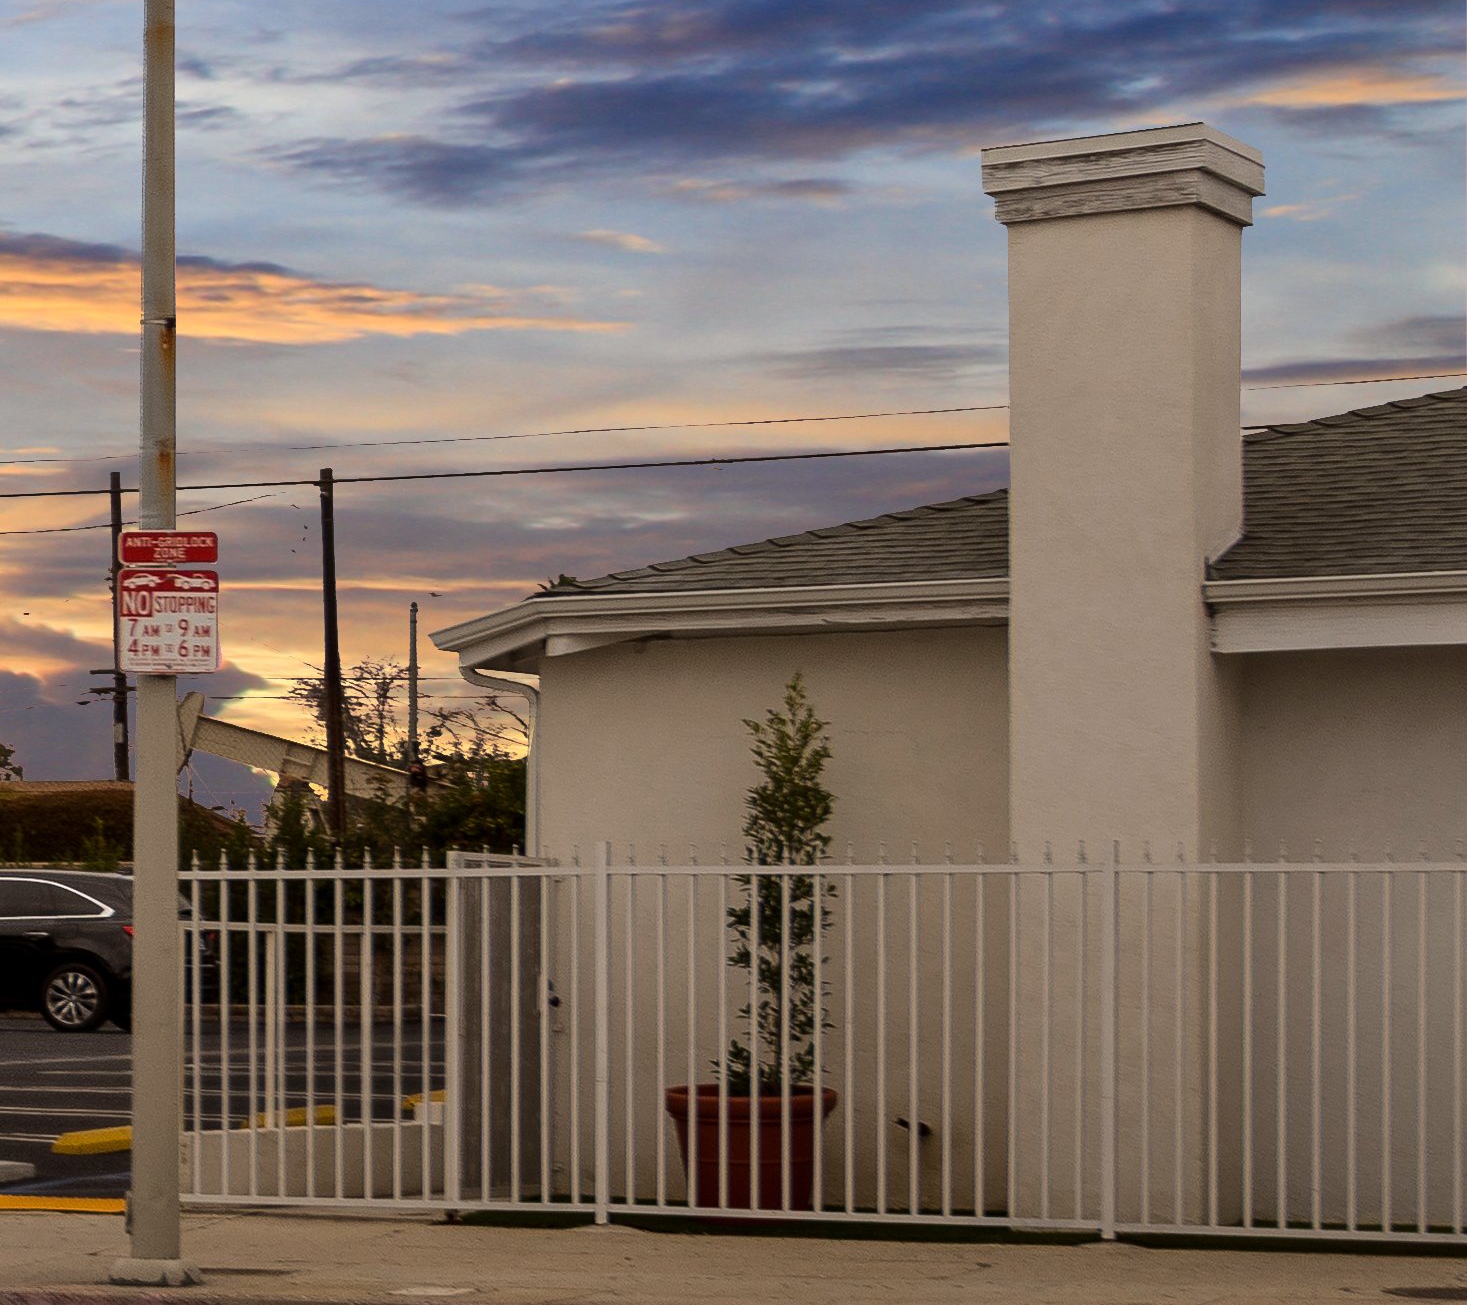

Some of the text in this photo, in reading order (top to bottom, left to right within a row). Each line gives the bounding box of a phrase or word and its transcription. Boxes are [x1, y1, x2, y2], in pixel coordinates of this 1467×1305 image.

[125, 536, 215, 548] ANTI-GRIDLOCK
[153, 547, 187, 559] ZONE
[122, 591, 216, 615] NO STOPPING
[127, 618, 139, 637] 7
[143, 625, 161, 638] AM
[178, 618, 189, 637] 9
[194, 625, 212, 638] AM
[127, 639, 139, 657] 4
[142, 644, 160, 657] PM
[178, 639, 189, 658] 6
[193, 644, 211, 658] PM
